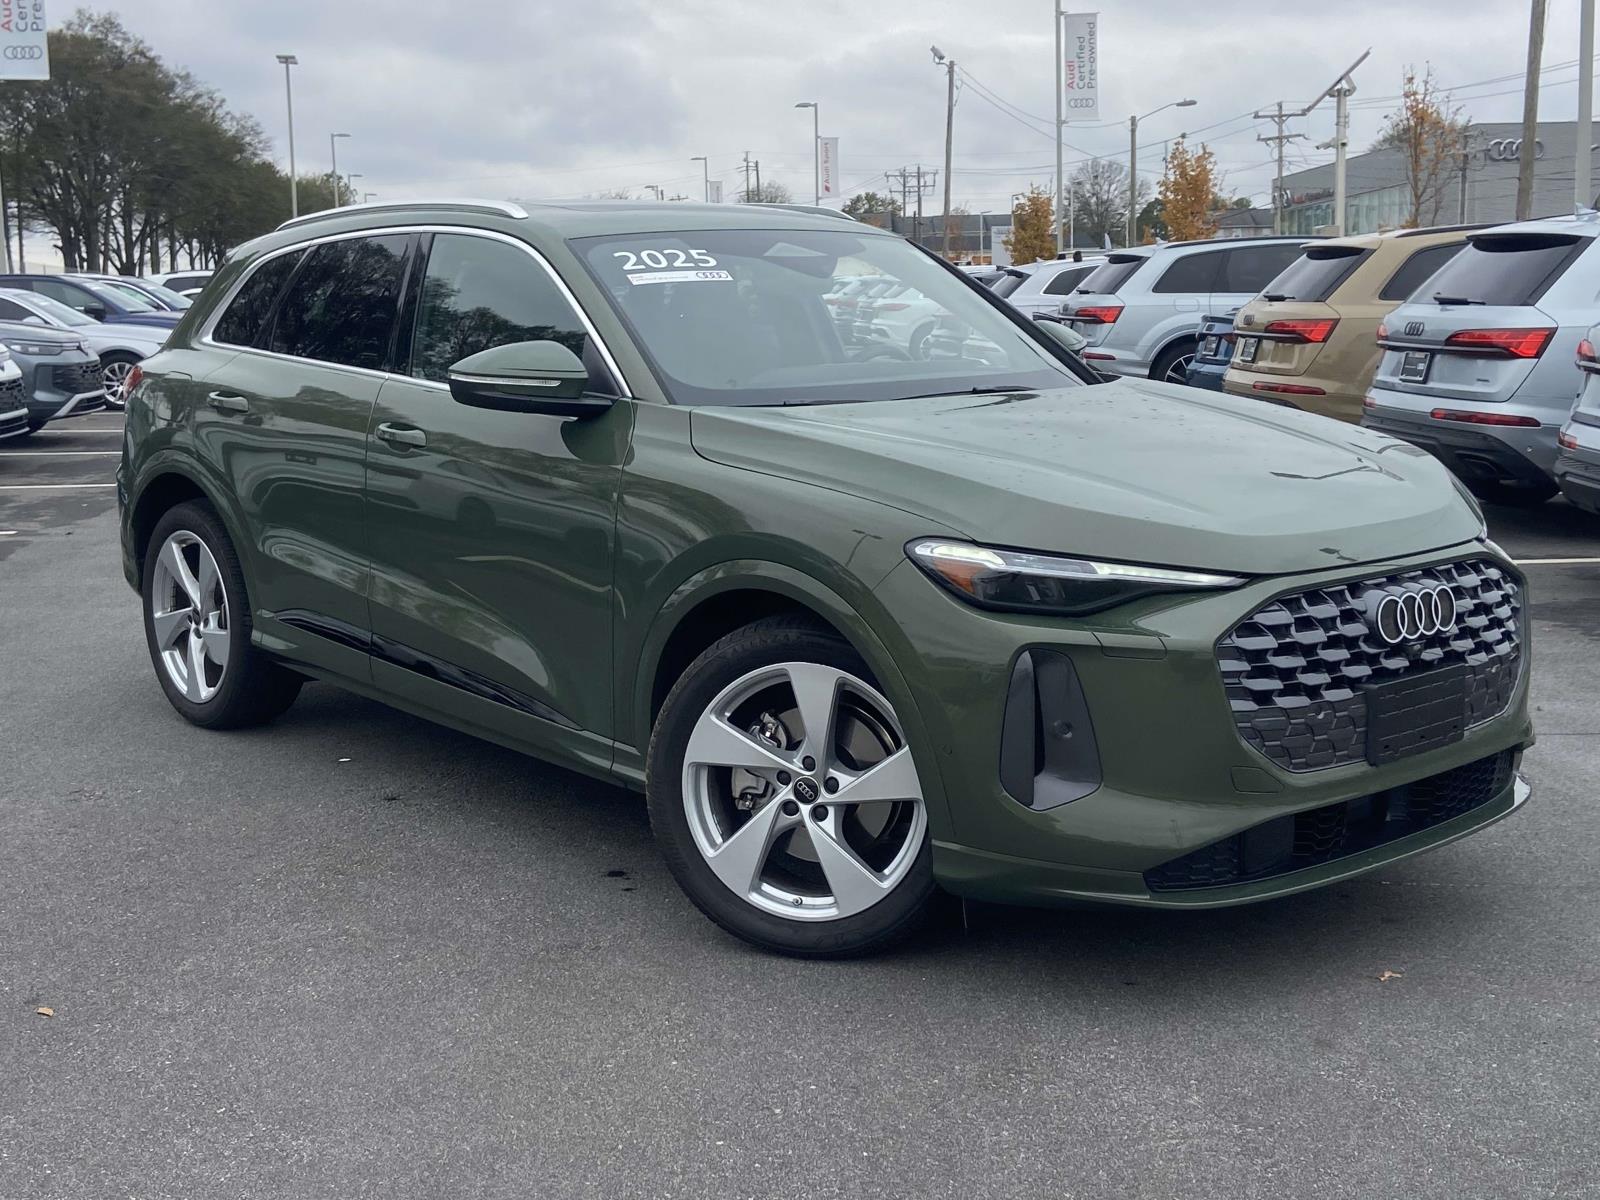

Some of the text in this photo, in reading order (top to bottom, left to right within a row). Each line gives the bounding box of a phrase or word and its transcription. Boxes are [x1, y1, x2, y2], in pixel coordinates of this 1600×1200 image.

[1066, 60, 1075, 90] Audi
[1076, 36, 1086, 90] Certified
[1086, 22, 1096, 89] Pre-owned
[613, 249, 717, 271] 2025
